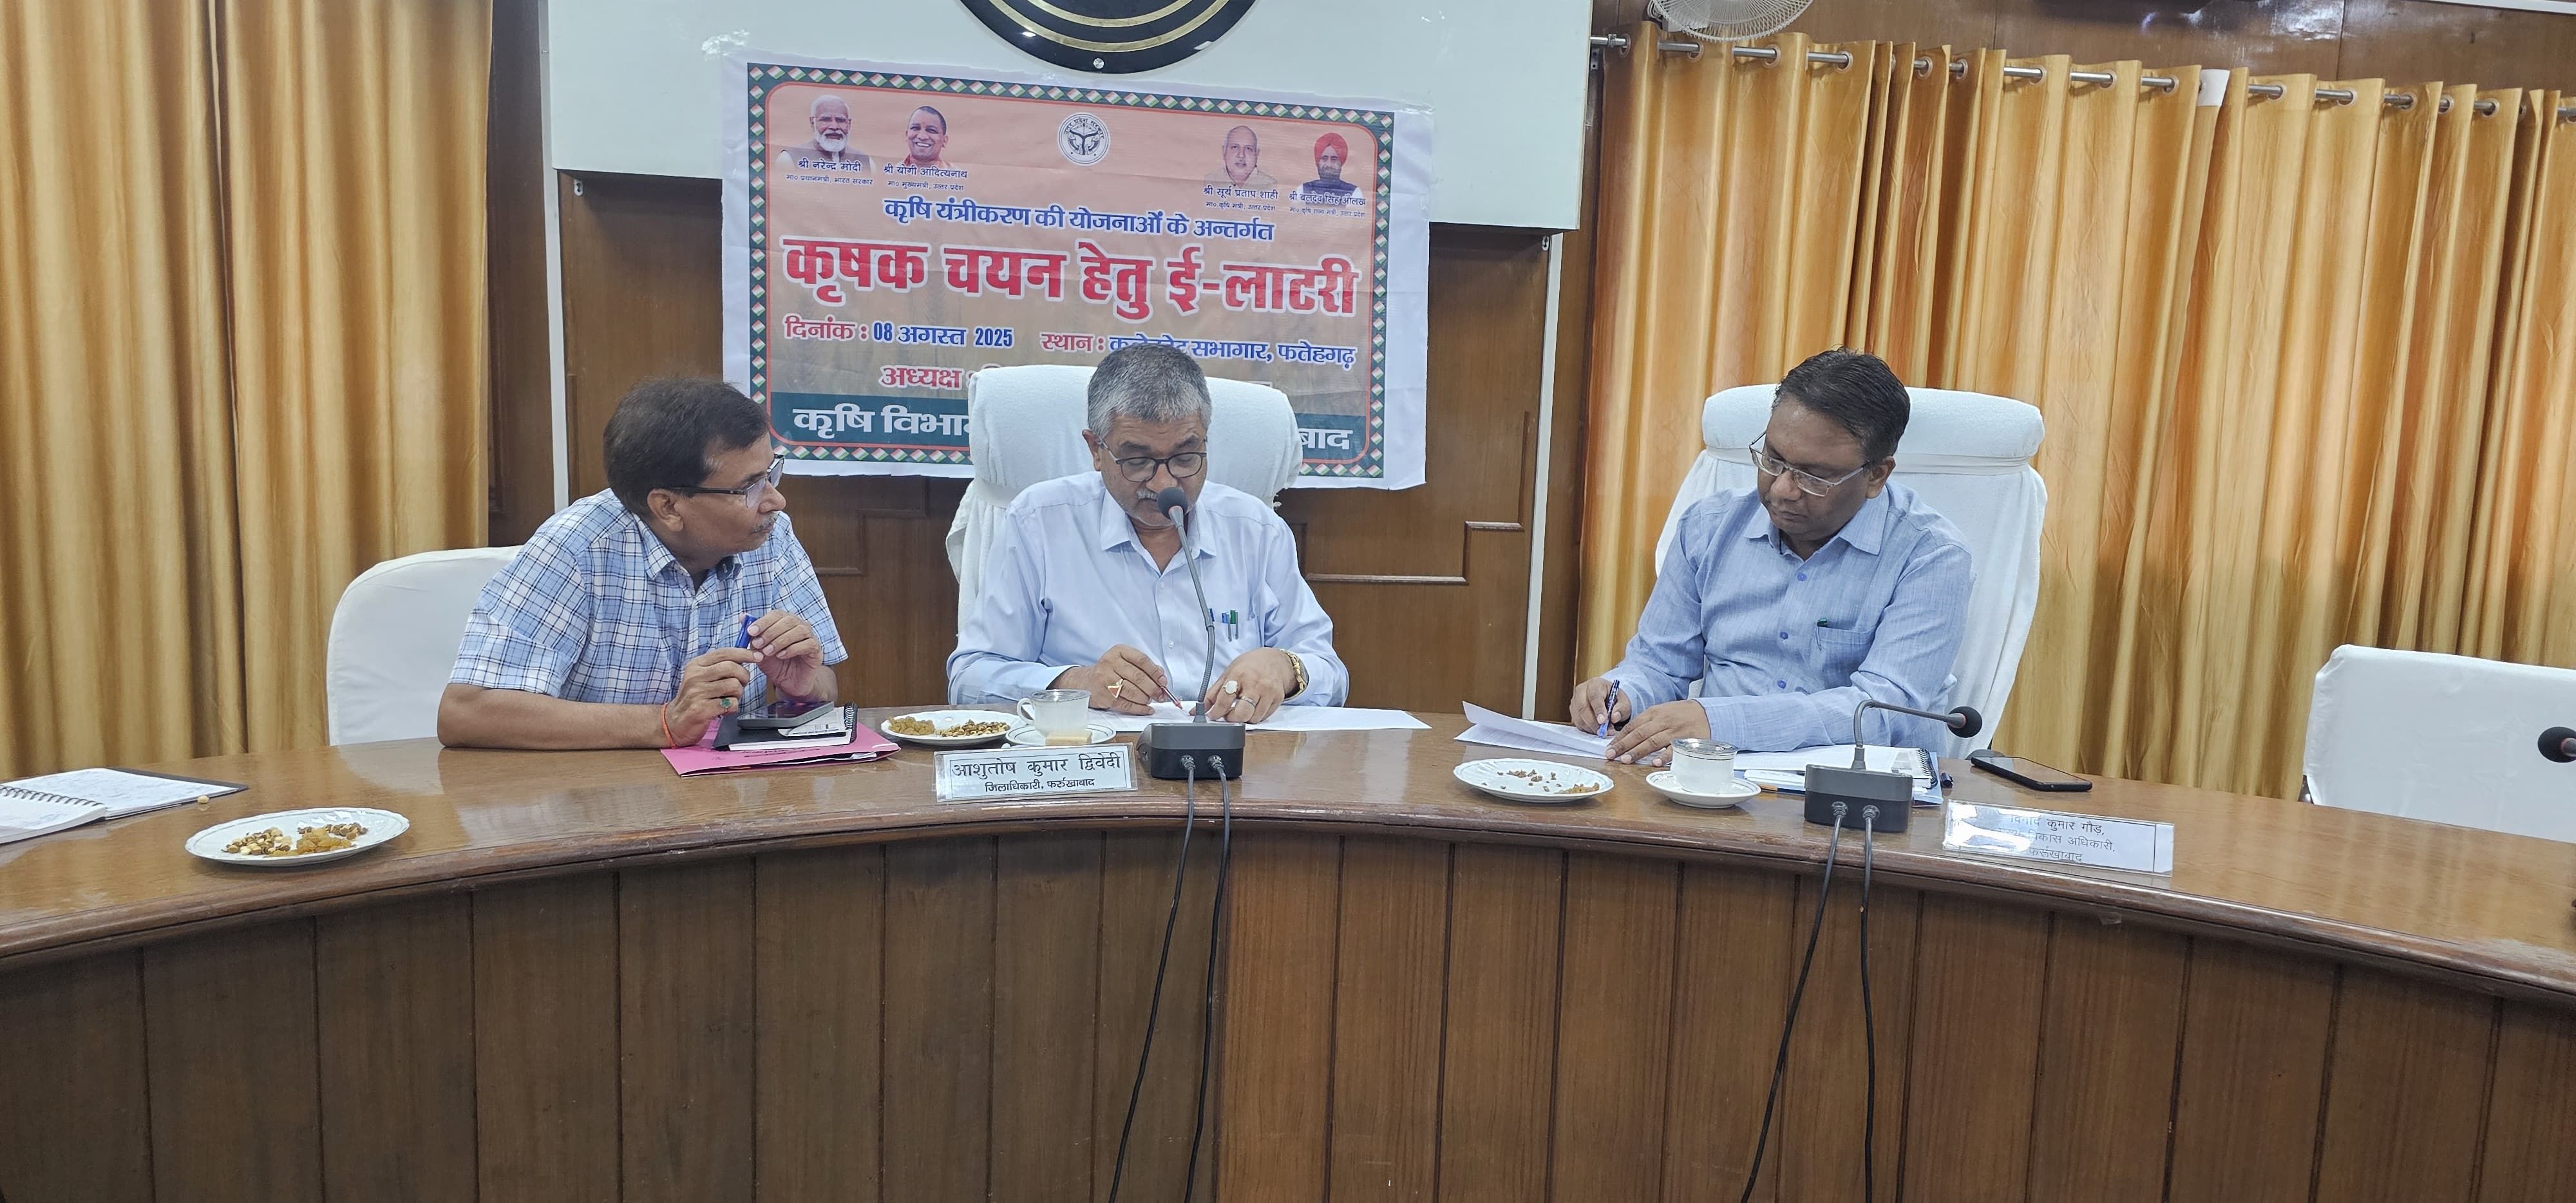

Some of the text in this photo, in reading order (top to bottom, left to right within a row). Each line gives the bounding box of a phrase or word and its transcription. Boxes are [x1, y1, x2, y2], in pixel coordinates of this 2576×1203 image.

[799, 158, 861, 171] श्री नरेन्द्र मोदी
[884, 164, 967, 178] श्री योगी आदित्यनाथ
[1204, 185, 1278, 200] श्री सूर्य प्रताप शाही
[1300, 192, 1322, 203] बलदेव
[1325, 192, 1340, 204] सिंह
[884, 196, 1275, 240] कृषि यंत्रीकरण की योजनाओं के अन्तर्गत
[783, 239, 1359, 320] कृषक चयन हेतु ई-लाटरी
[784, 315, 855, 339] दिनांक
[874, 321, 893, 342] 08
[898, 326, 967, 345] अगस्त
[974, 327, 1014, 347] 2025
[1040, 332, 1094, 352] स्थान
[1192, 339, 1273, 363] सभागार,
[1278, 340, 1356, 368] फतेहगढ़
[882, 366, 964, 389] अध्यक्ष
[792, 403, 969, 439] कृषि विभा
[952, 752, 1121, 780] आशुतोष कुमार द्विवेदी
[985, 780, 1044, 793] जिलाधिकारी,
[2047, 819, 2076, 831] कुमार
